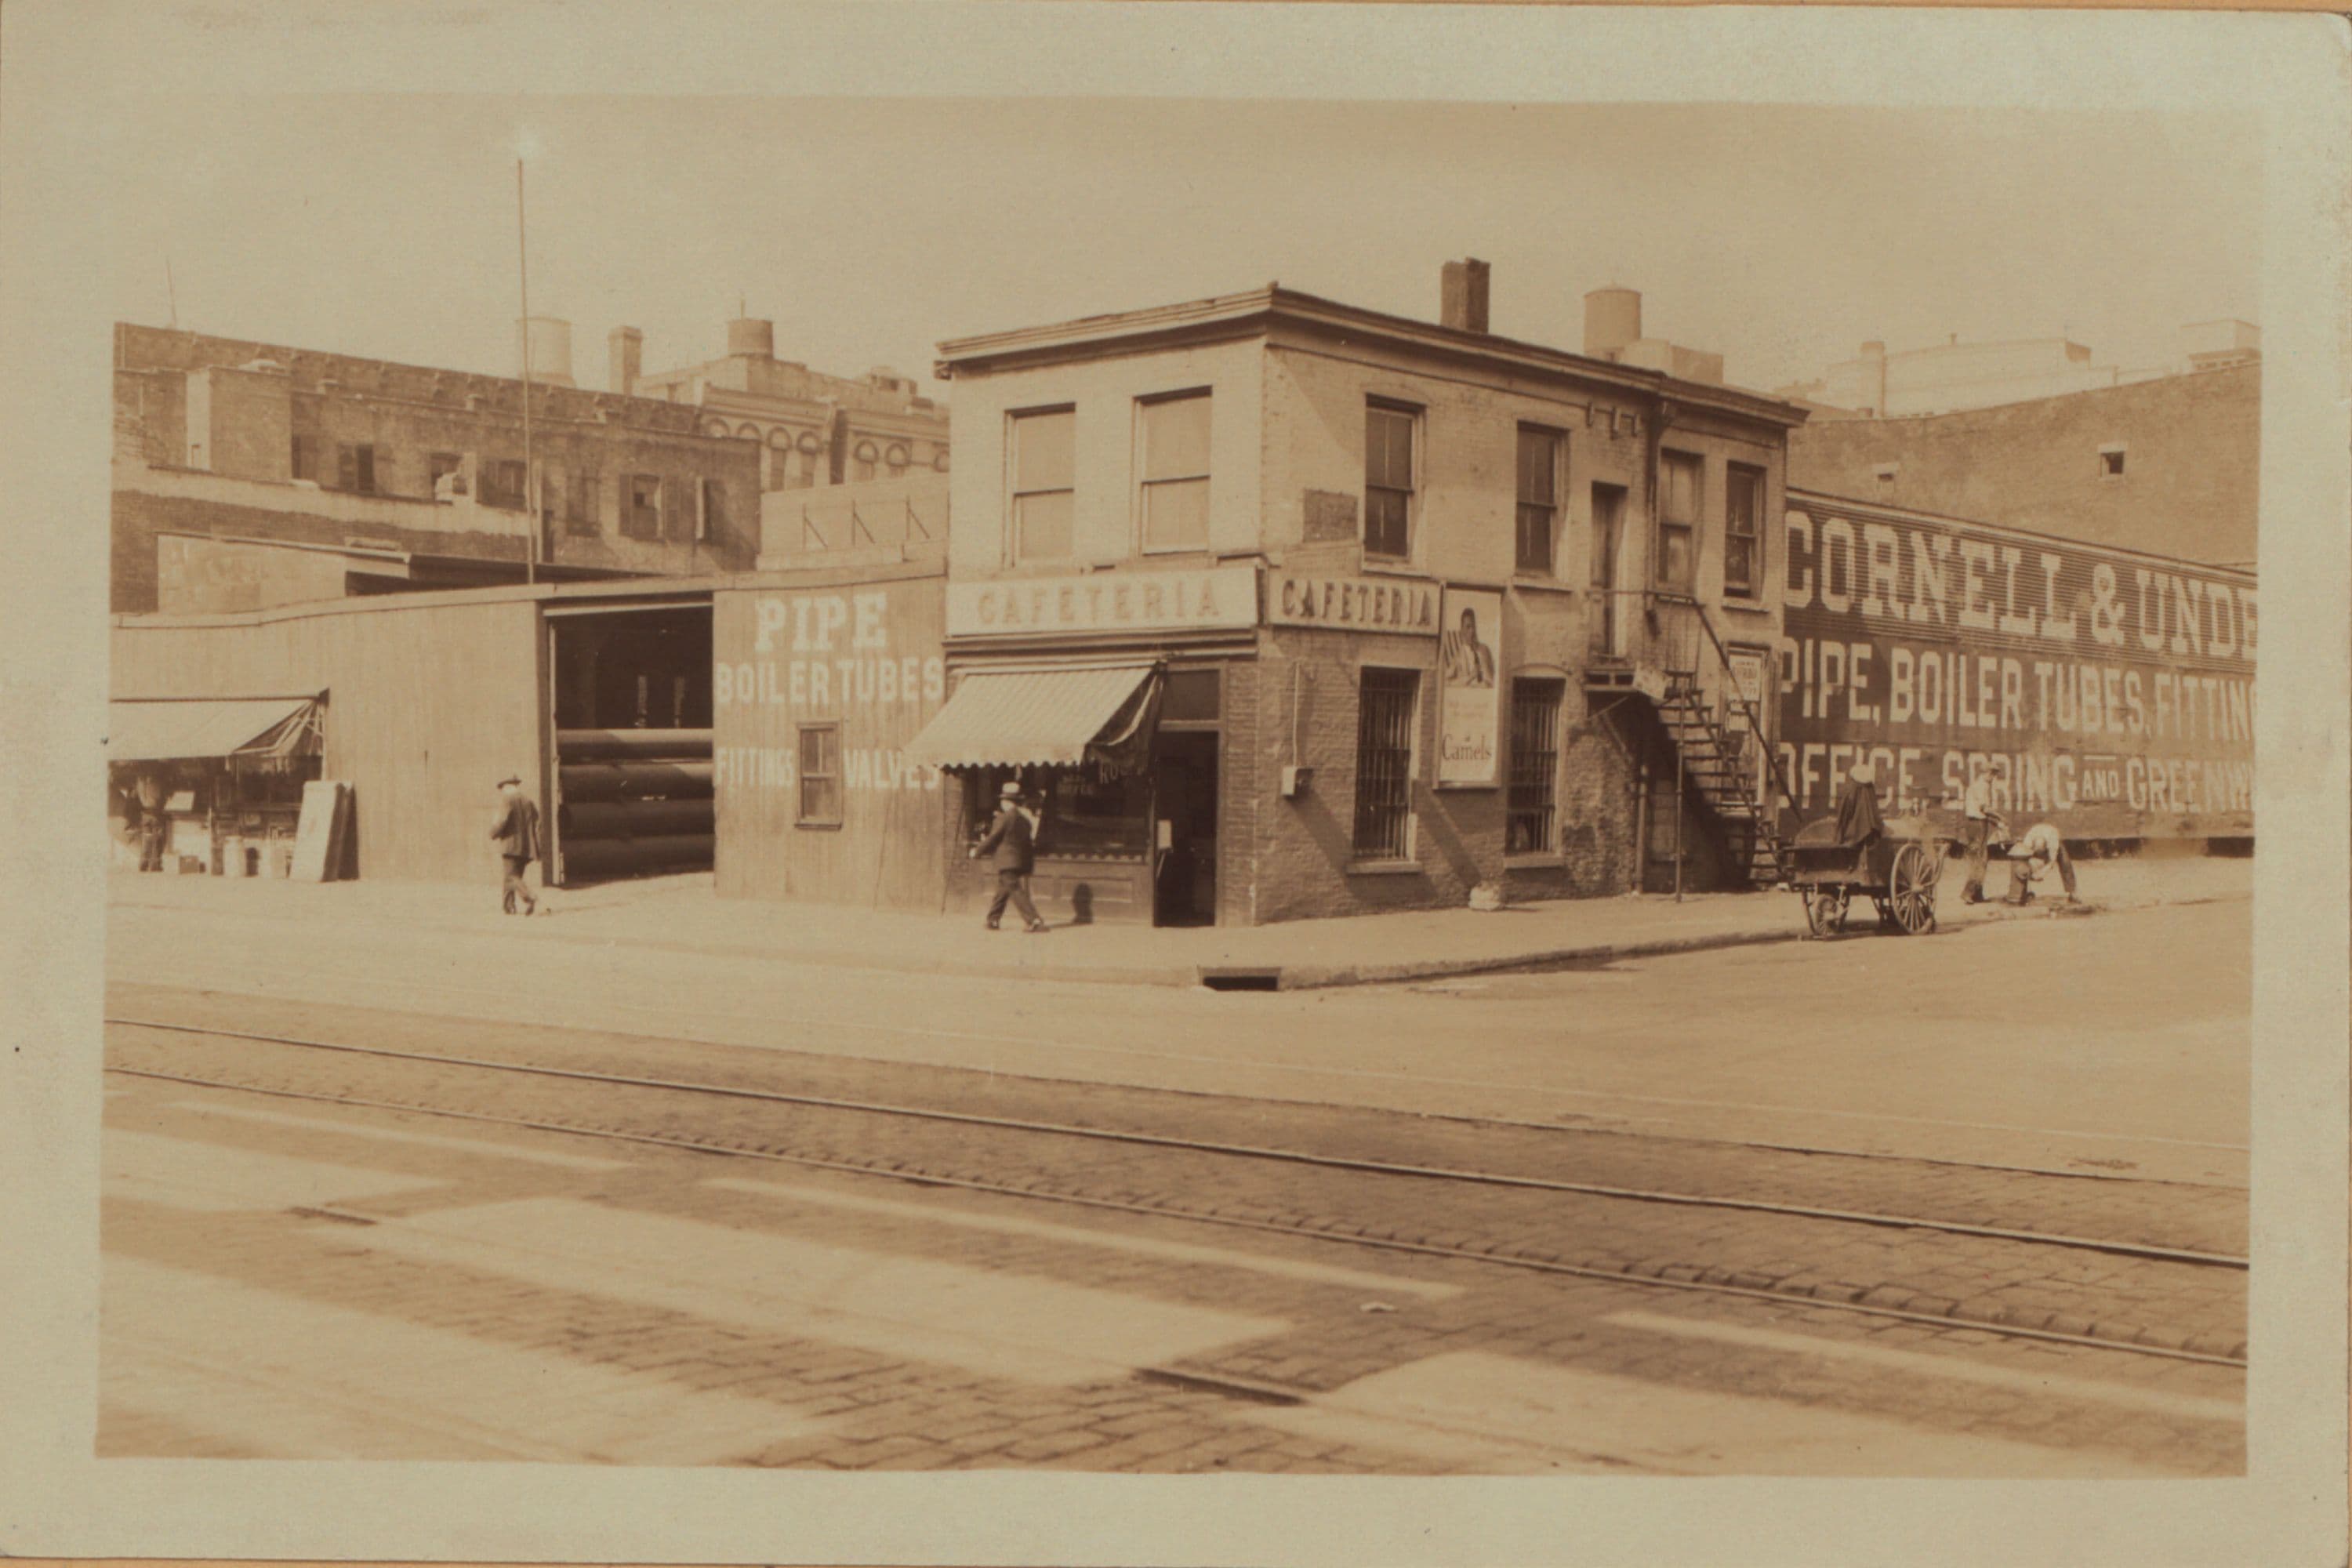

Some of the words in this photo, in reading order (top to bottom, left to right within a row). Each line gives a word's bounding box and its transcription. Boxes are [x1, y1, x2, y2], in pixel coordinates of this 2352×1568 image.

[1784, 510, 2076, 640] CORNELL
[2092, 562, 2125, 645] &
[754, 591, 887, 653] PIPE
[978, 579, 1220, 625] CAFETERIA
[1281, 579, 1432, 626] CAFETERIA
[716, 662, 831, 705] BOILER
[837, 655, 943, 702] TUBES
[1889, 647, 2023, 730] BOILER
[2154, 672, 2256, 741] FITTIN
[715, 746, 794, 789] FITTINGS
[1442, 733, 1493, 760] Camels
[2082, 769, 2120, 798] AND
